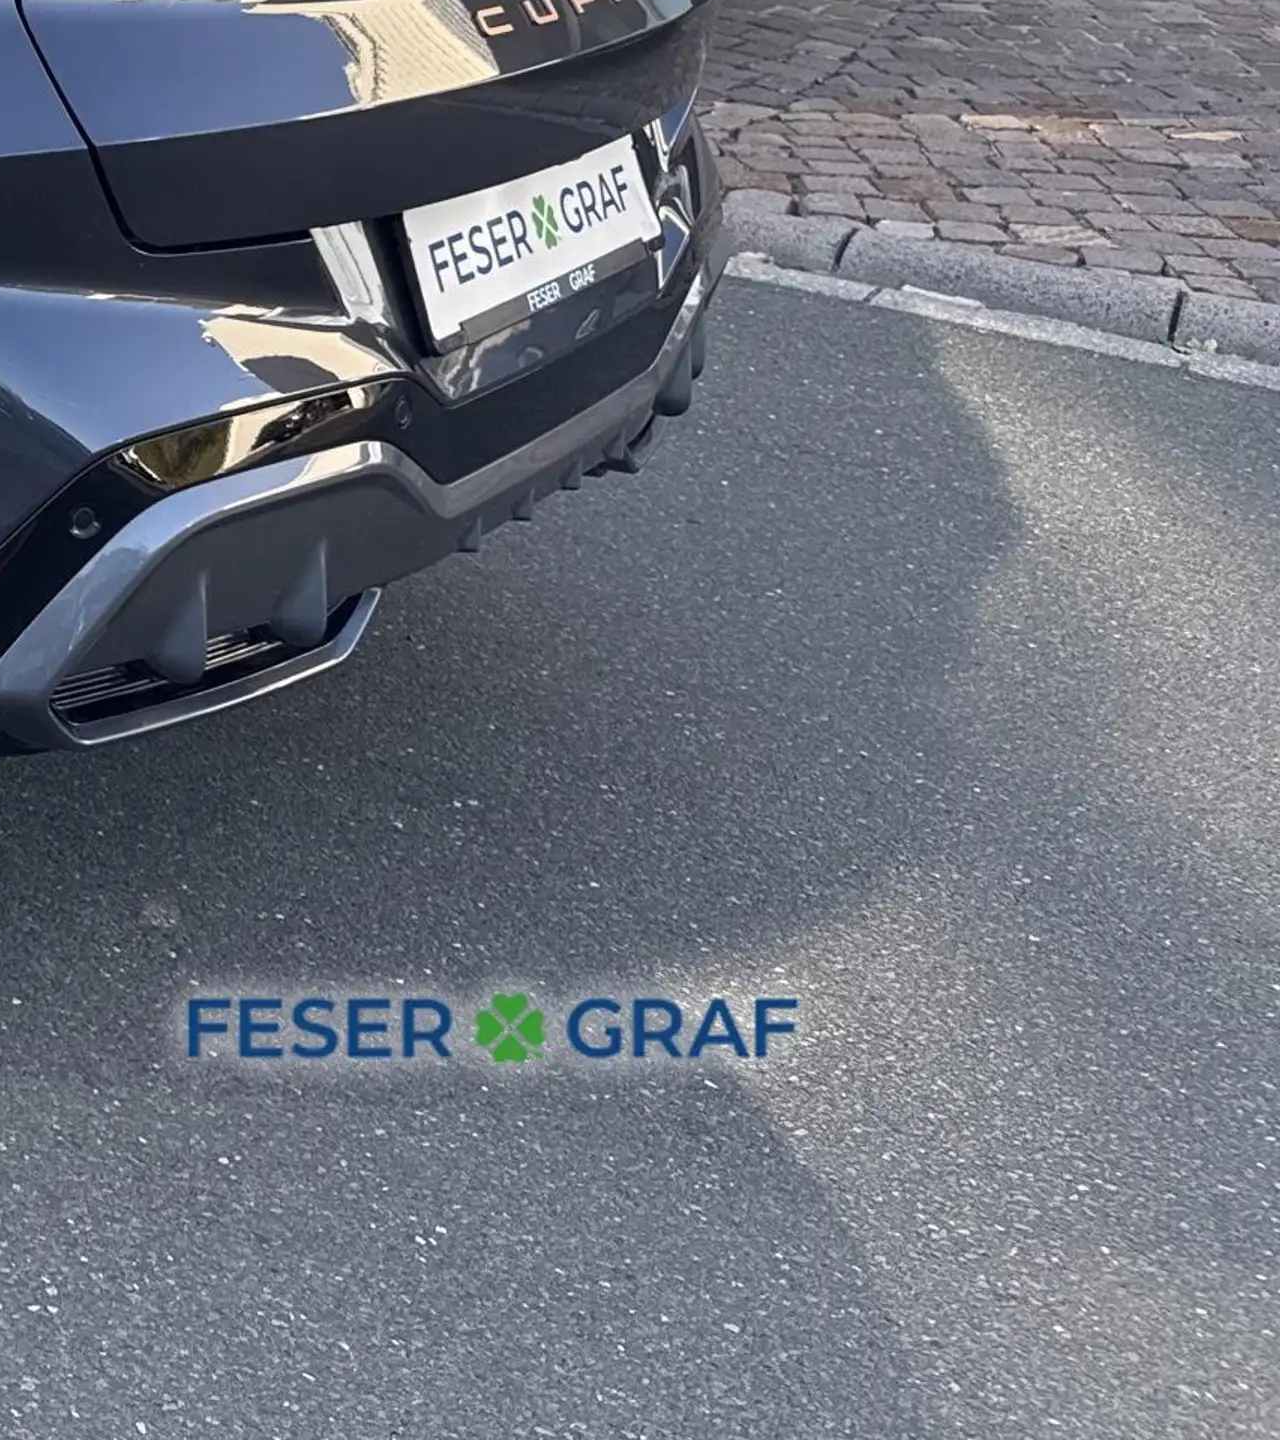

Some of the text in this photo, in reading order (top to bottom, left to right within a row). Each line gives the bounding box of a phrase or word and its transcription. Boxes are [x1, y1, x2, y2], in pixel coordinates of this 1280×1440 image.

[427, 164, 630, 293] FESER GRAF
[526, 263, 597, 313] FESER GRAF
